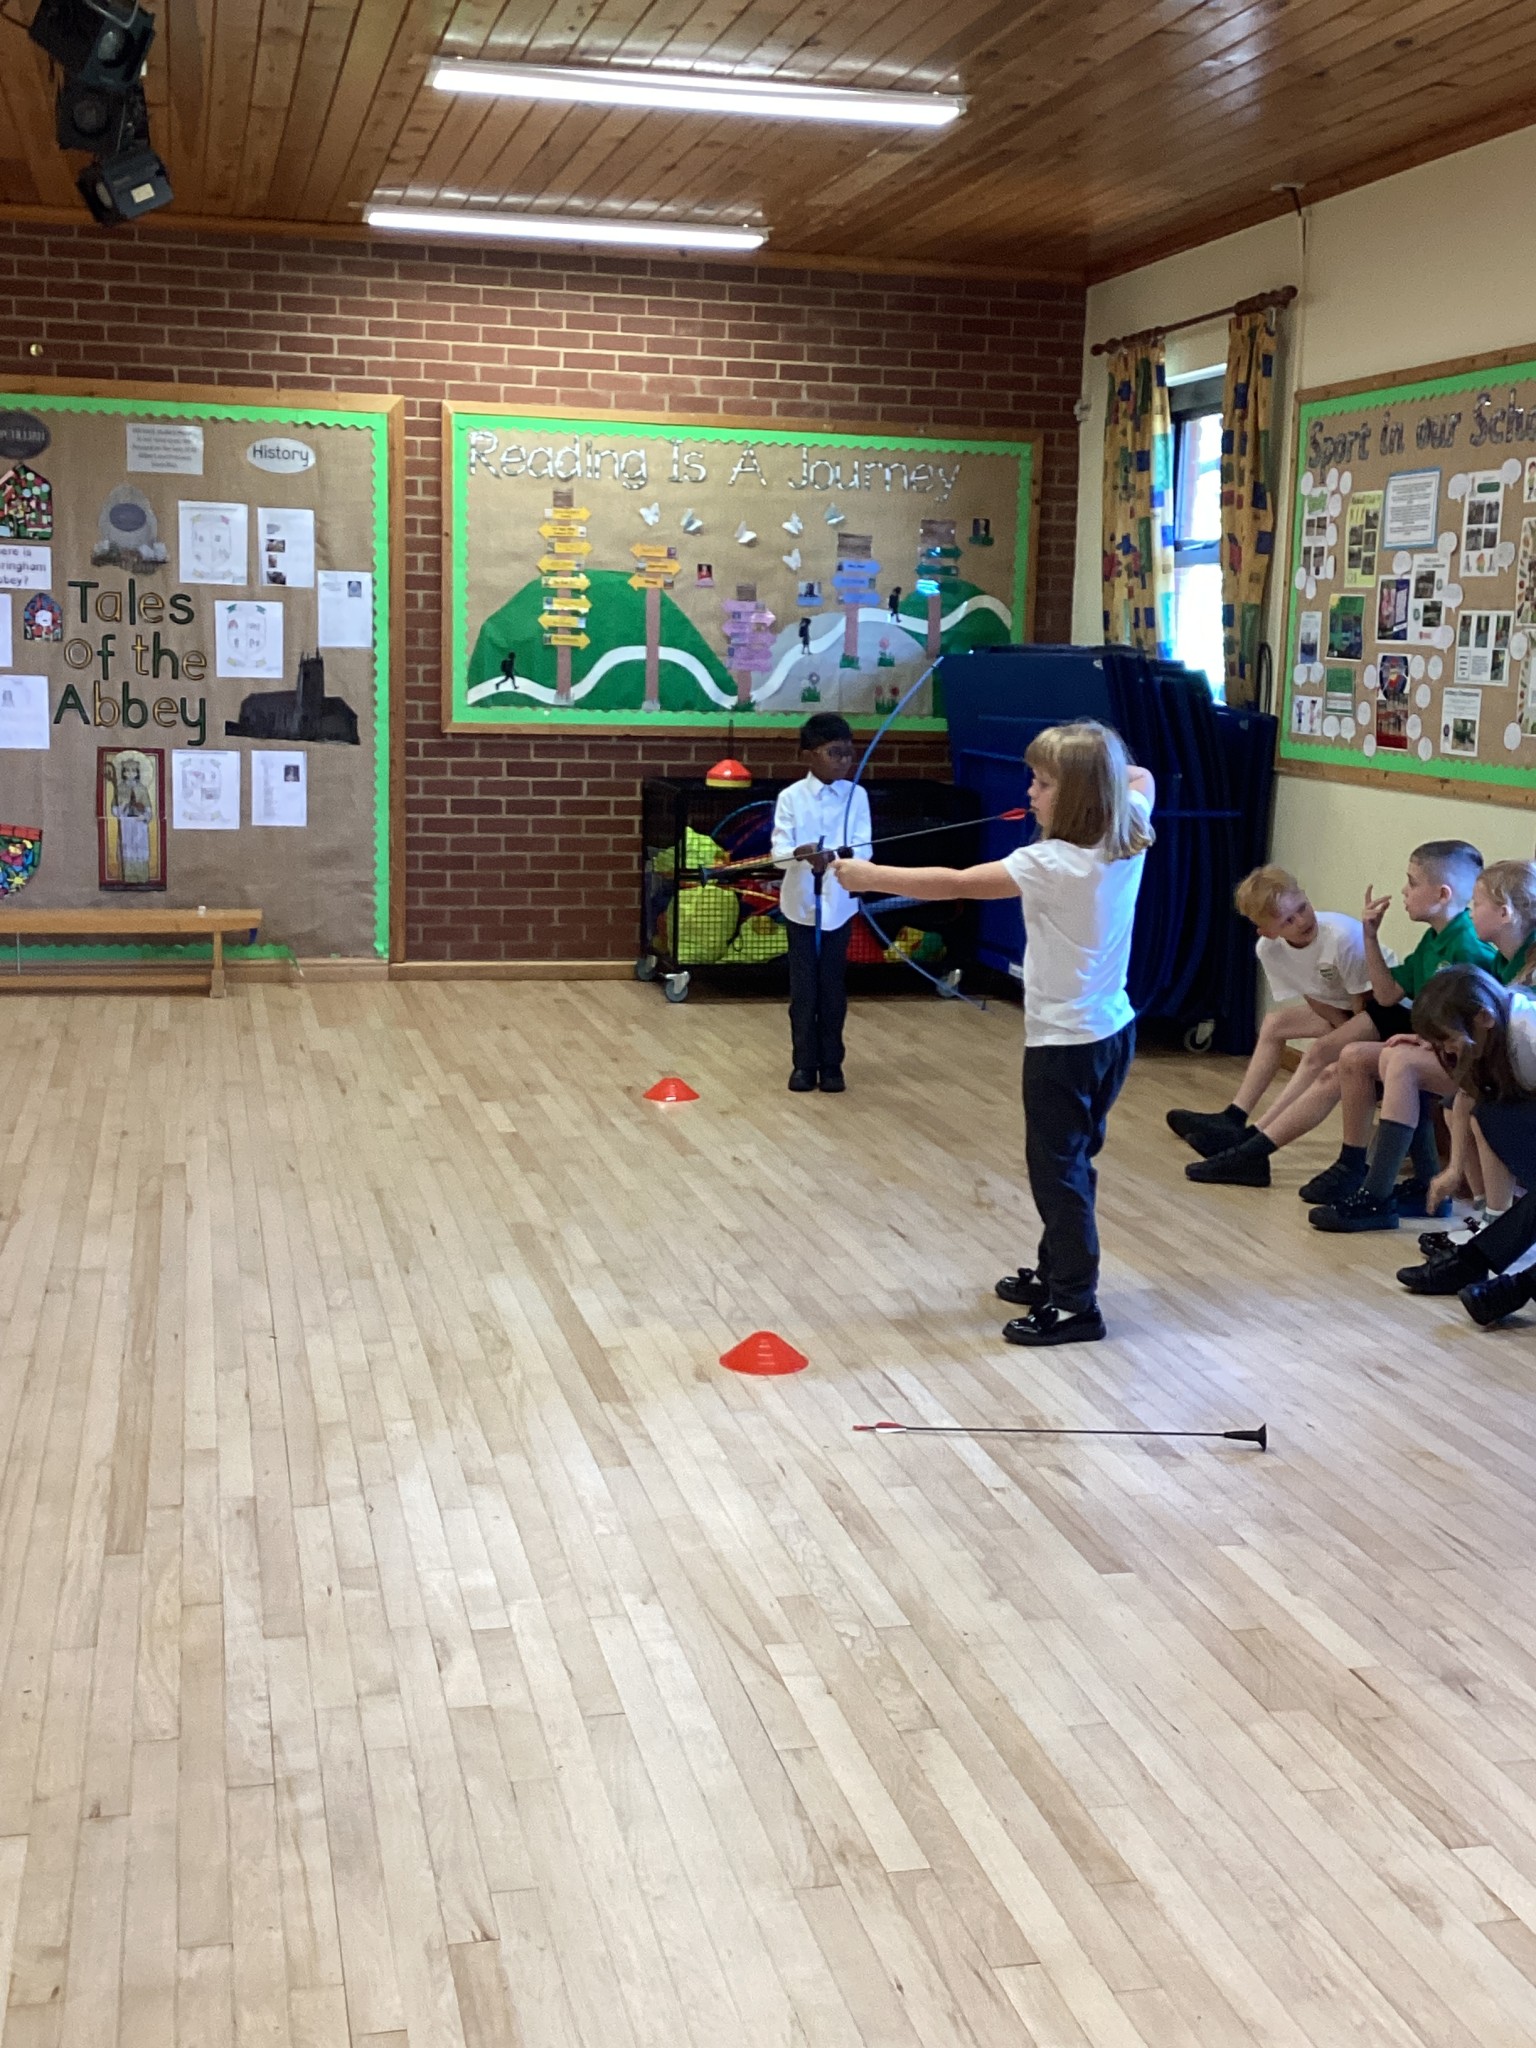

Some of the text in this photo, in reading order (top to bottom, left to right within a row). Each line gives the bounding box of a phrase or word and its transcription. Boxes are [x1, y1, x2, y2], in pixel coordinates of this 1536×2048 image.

[252, 444, 309, 468] History
[469, 431, 960, 503] Reading Is A Journey
[1308, 420, 1372, 485] Sport
[1380, 410, 1405, 456] in
[1416, 410, 1462, 449] our
[67, 578, 195, 625] Tales
[64, 631, 208, 681] of the
[53, 680, 207, 747] Abbey
